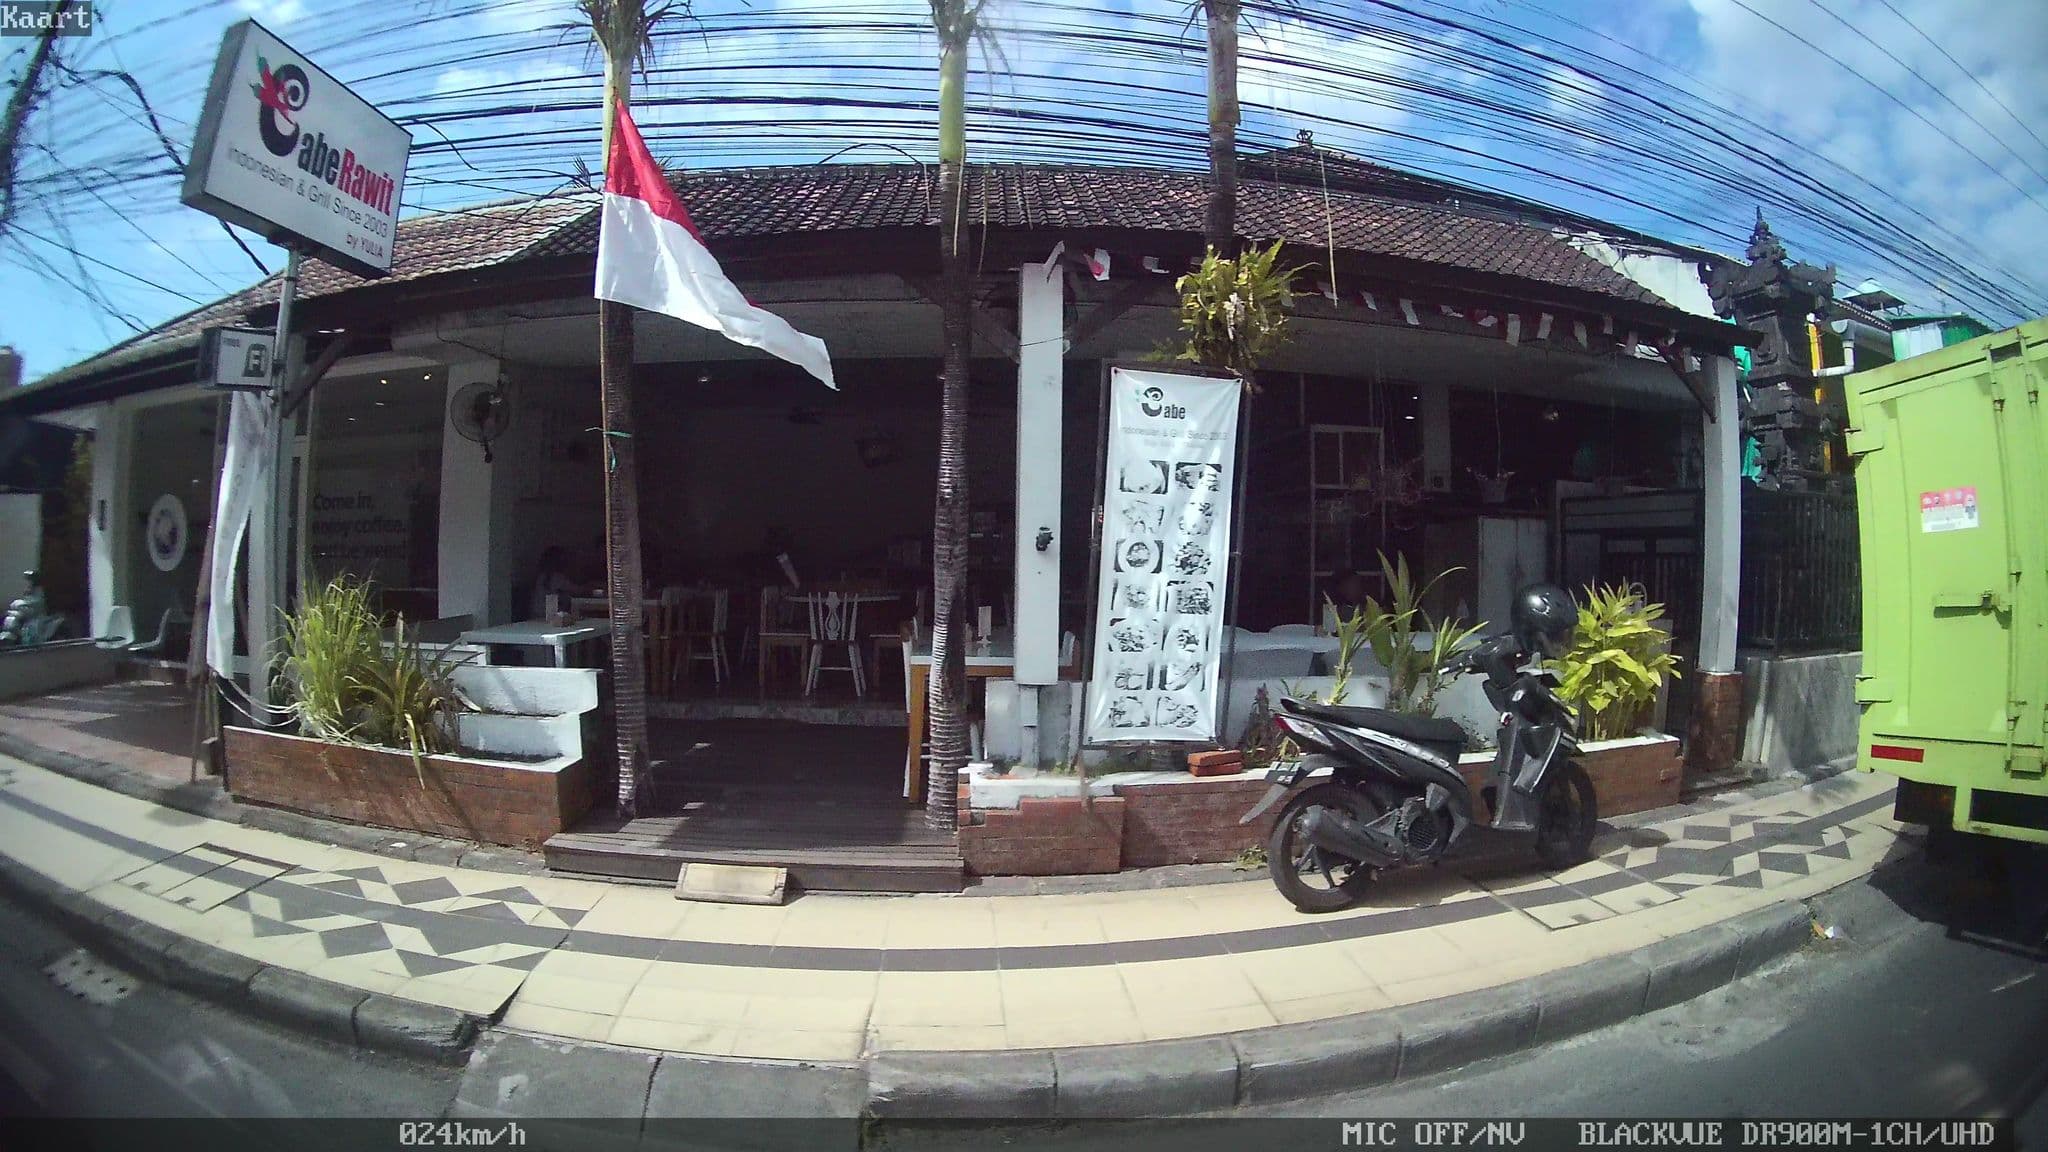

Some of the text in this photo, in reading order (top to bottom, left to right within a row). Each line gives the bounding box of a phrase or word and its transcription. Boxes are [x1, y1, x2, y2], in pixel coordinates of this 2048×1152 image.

[297, 178, 305, 198] &
[333, 196, 361, 225] Since
[362, 212, 388, 238] 2003
